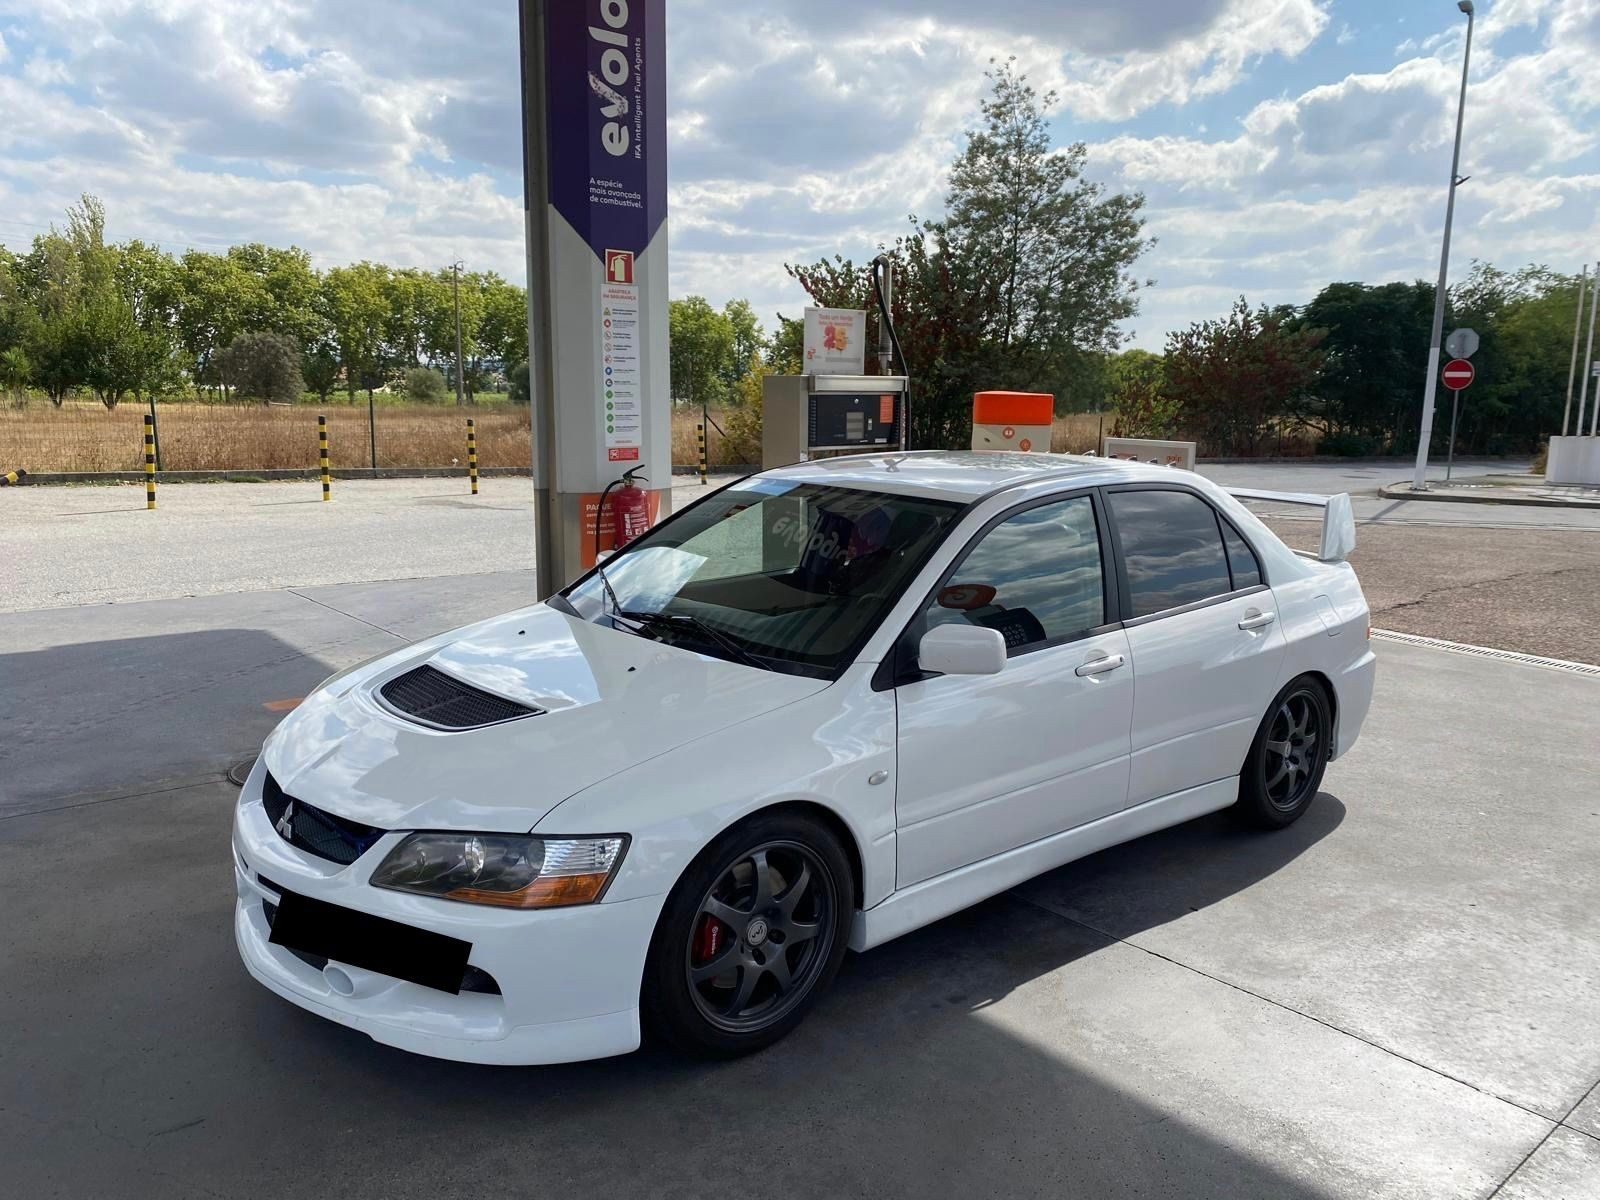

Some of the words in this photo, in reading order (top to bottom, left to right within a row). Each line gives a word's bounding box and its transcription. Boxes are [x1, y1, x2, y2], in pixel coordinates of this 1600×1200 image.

[634, 37, 643, 71] Agents
[634, 73, 642, 92] Fuel
[634, 95, 643, 141] Intelligent
[634, 143, 642, 159] IFA
[589, 177, 596, 185] A
[597, 179, 623, 189] espécie
[589, 187, 607, 195] mais
[607, 190, 641, 201] avançada
[589, 195, 599, 203] de
[599, 198, 644, 209] combustível.
